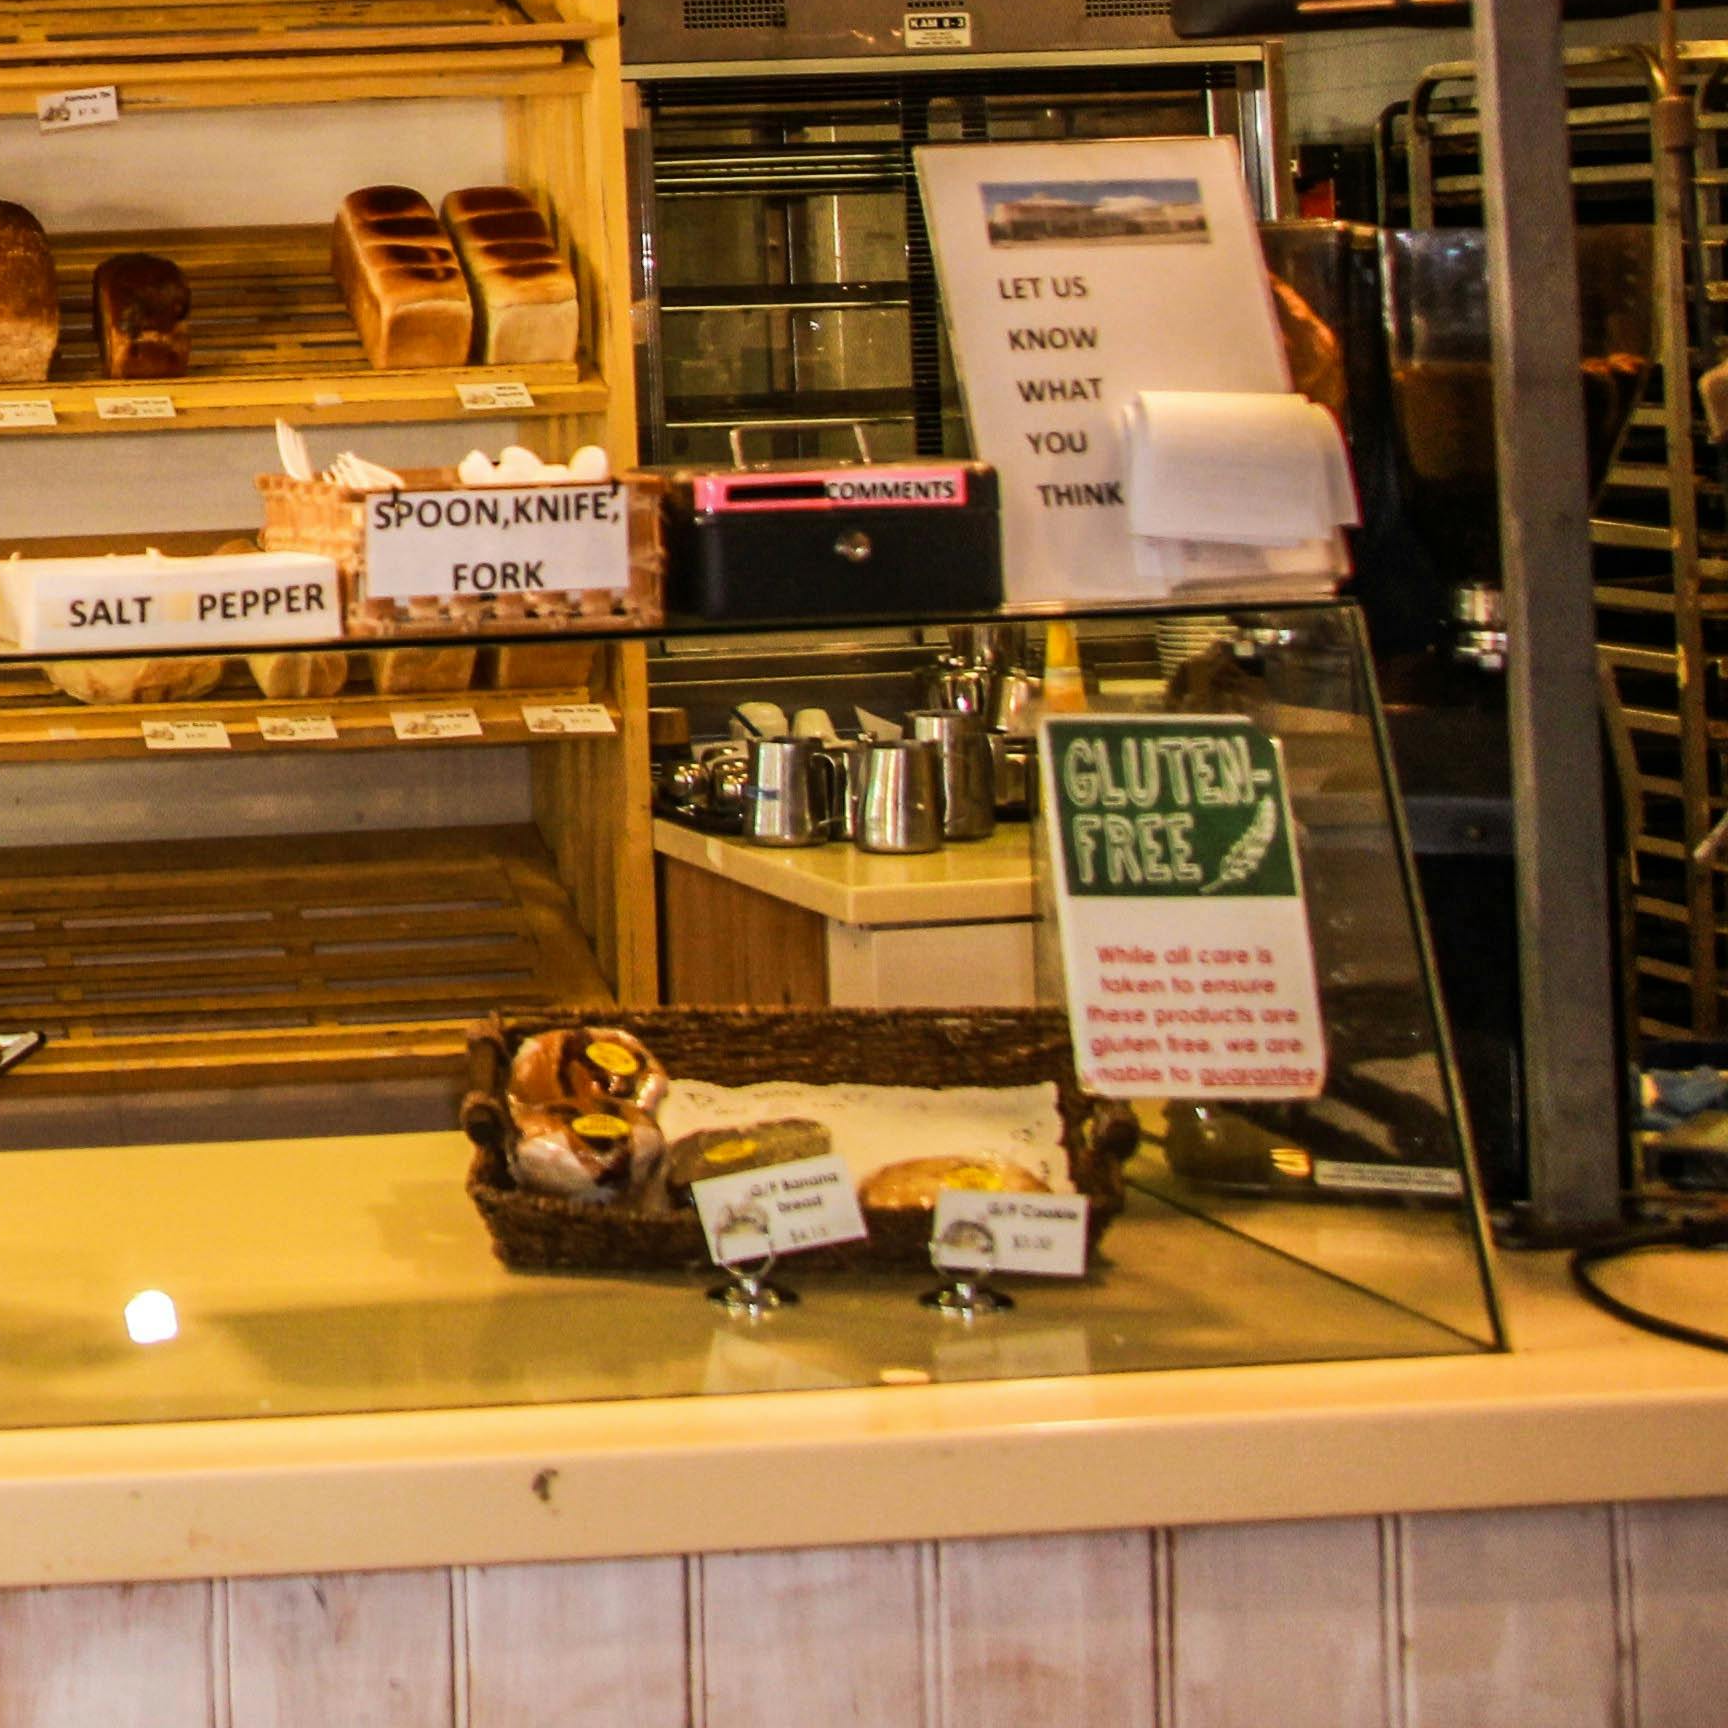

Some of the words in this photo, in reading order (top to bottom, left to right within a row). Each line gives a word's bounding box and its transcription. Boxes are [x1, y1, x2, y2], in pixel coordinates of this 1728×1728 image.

[999, 277, 1041, 300] LET
[1052, 276, 1088, 299] US
[1007, 327, 1098, 352] KNOW
[1017, 377, 1103, 403] WHAT
[1027, 430, 1088, 455] YOU
[826, 478, 957, 503] COMMENTS
[1036, 482, 1126, 508] THINK
[452, 561, 545, 591] FORK
[69, 596, 152, 628] SALT
[197, 583, 326, 621] PEPPER
[1073, 812, 1203, 885] FREE
[1097, 945, 1157, 964] While
[1164, 945, 1192, 964] all
[1198, 949, 1250, 964] care
[1100, 977, 1164, 993] taken
[1171, 977, 1193, 993] to
[1201, 979, 1276, 993] ensure
[1154, 1007, 1254, 1027] products
[1261, 1009, 1298, 1023] are
[1091, 1035, 1159, 1056] gluten
[1224, 1039, 1258, 1053] we
[1265, 1038, 1302, 1053] are
[1169, 1066, 1192, 1082] to
